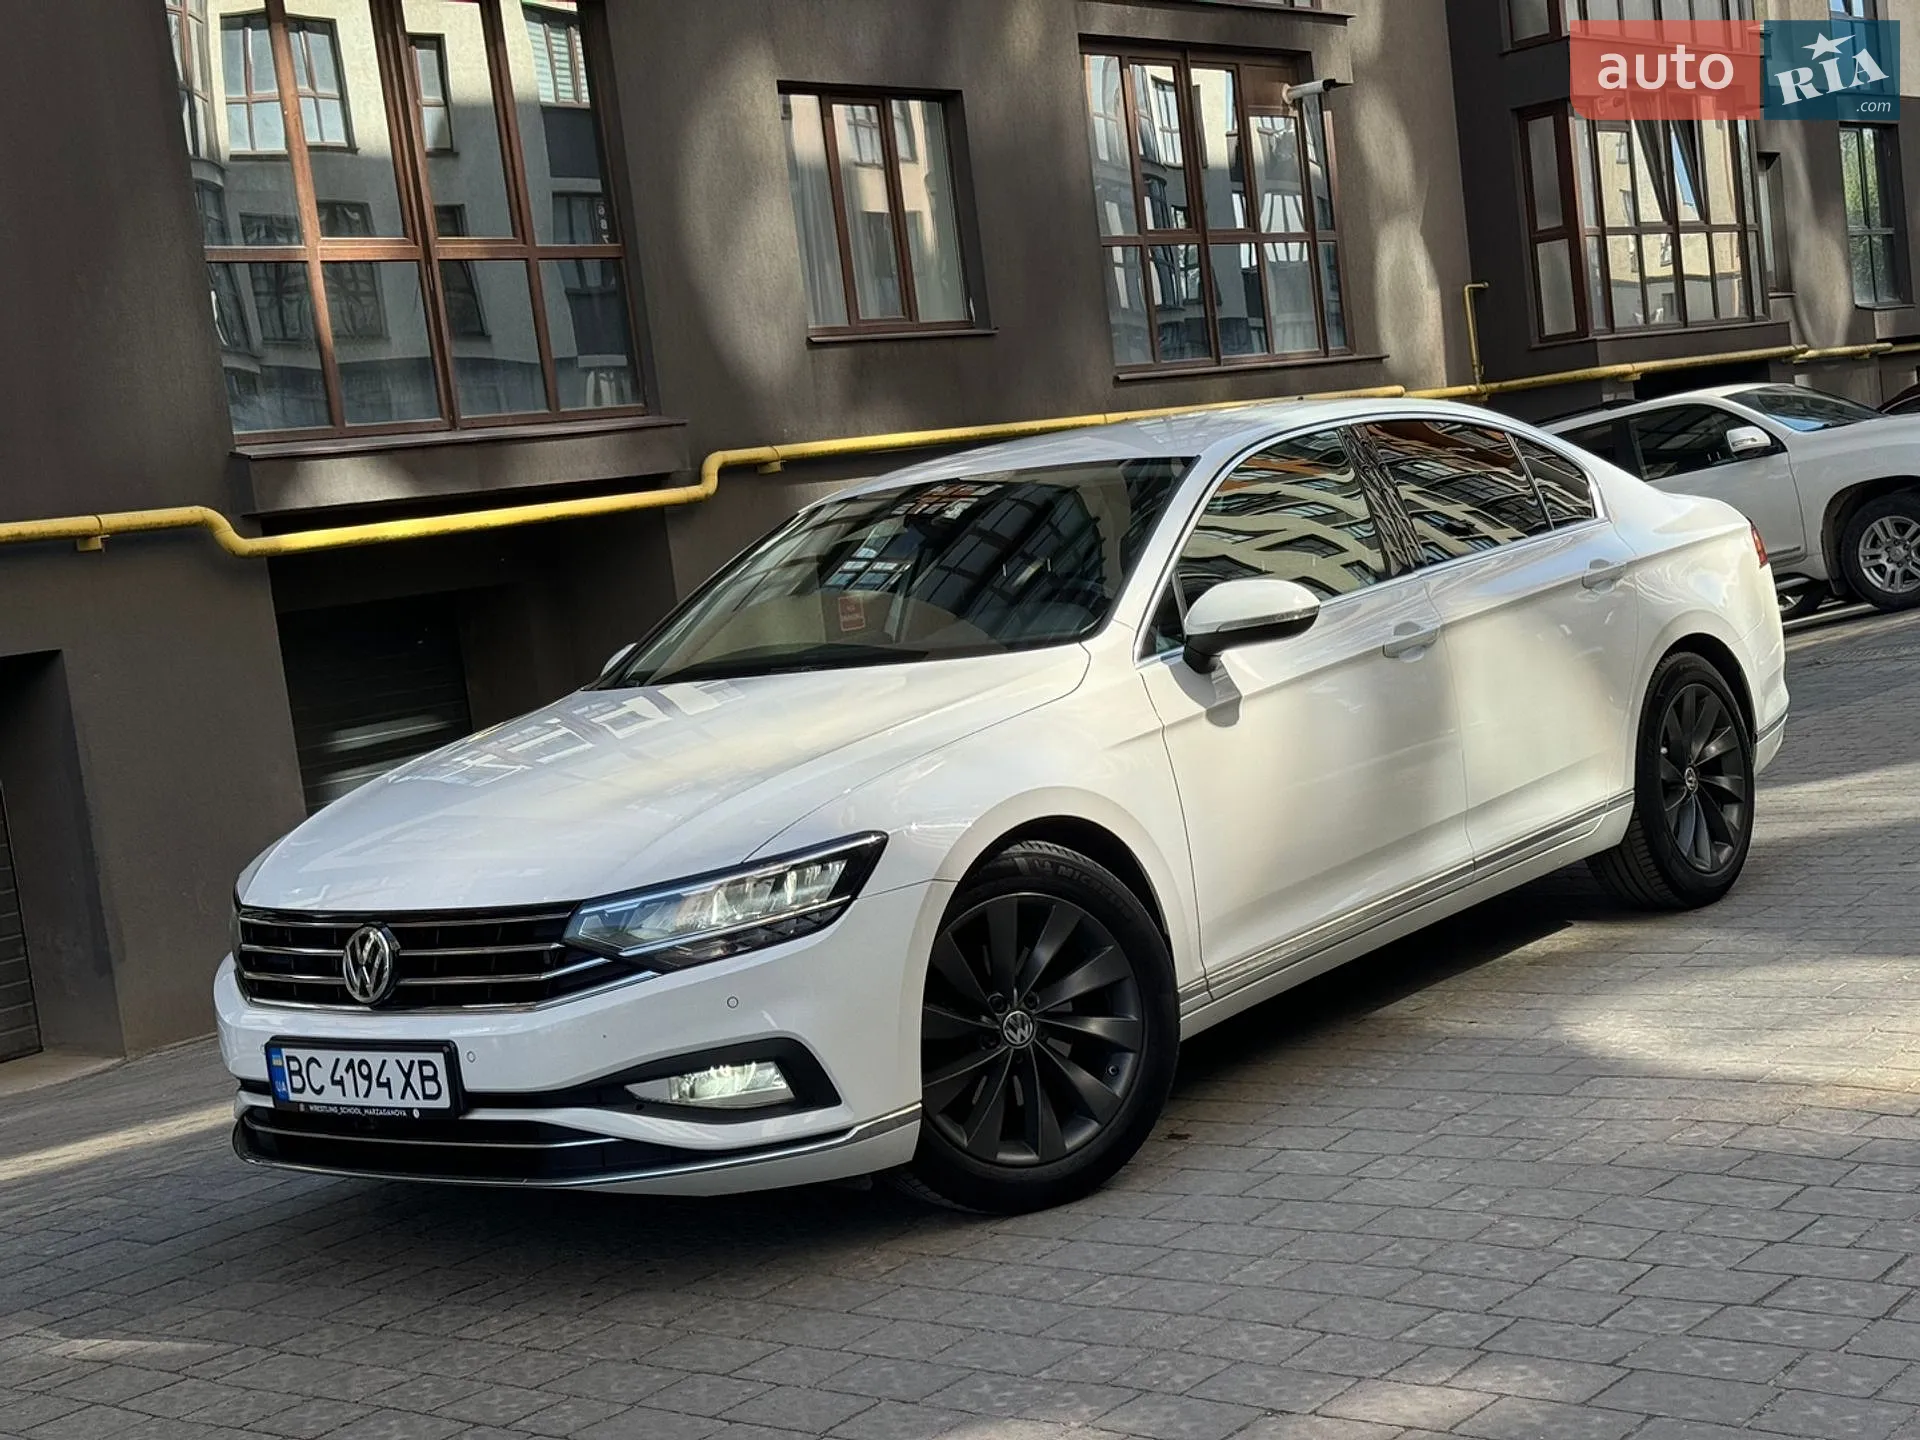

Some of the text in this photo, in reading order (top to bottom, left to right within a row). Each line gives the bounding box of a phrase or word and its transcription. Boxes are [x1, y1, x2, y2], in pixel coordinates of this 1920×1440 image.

[285, 1055, 443, 1101] BC 4194 XB
